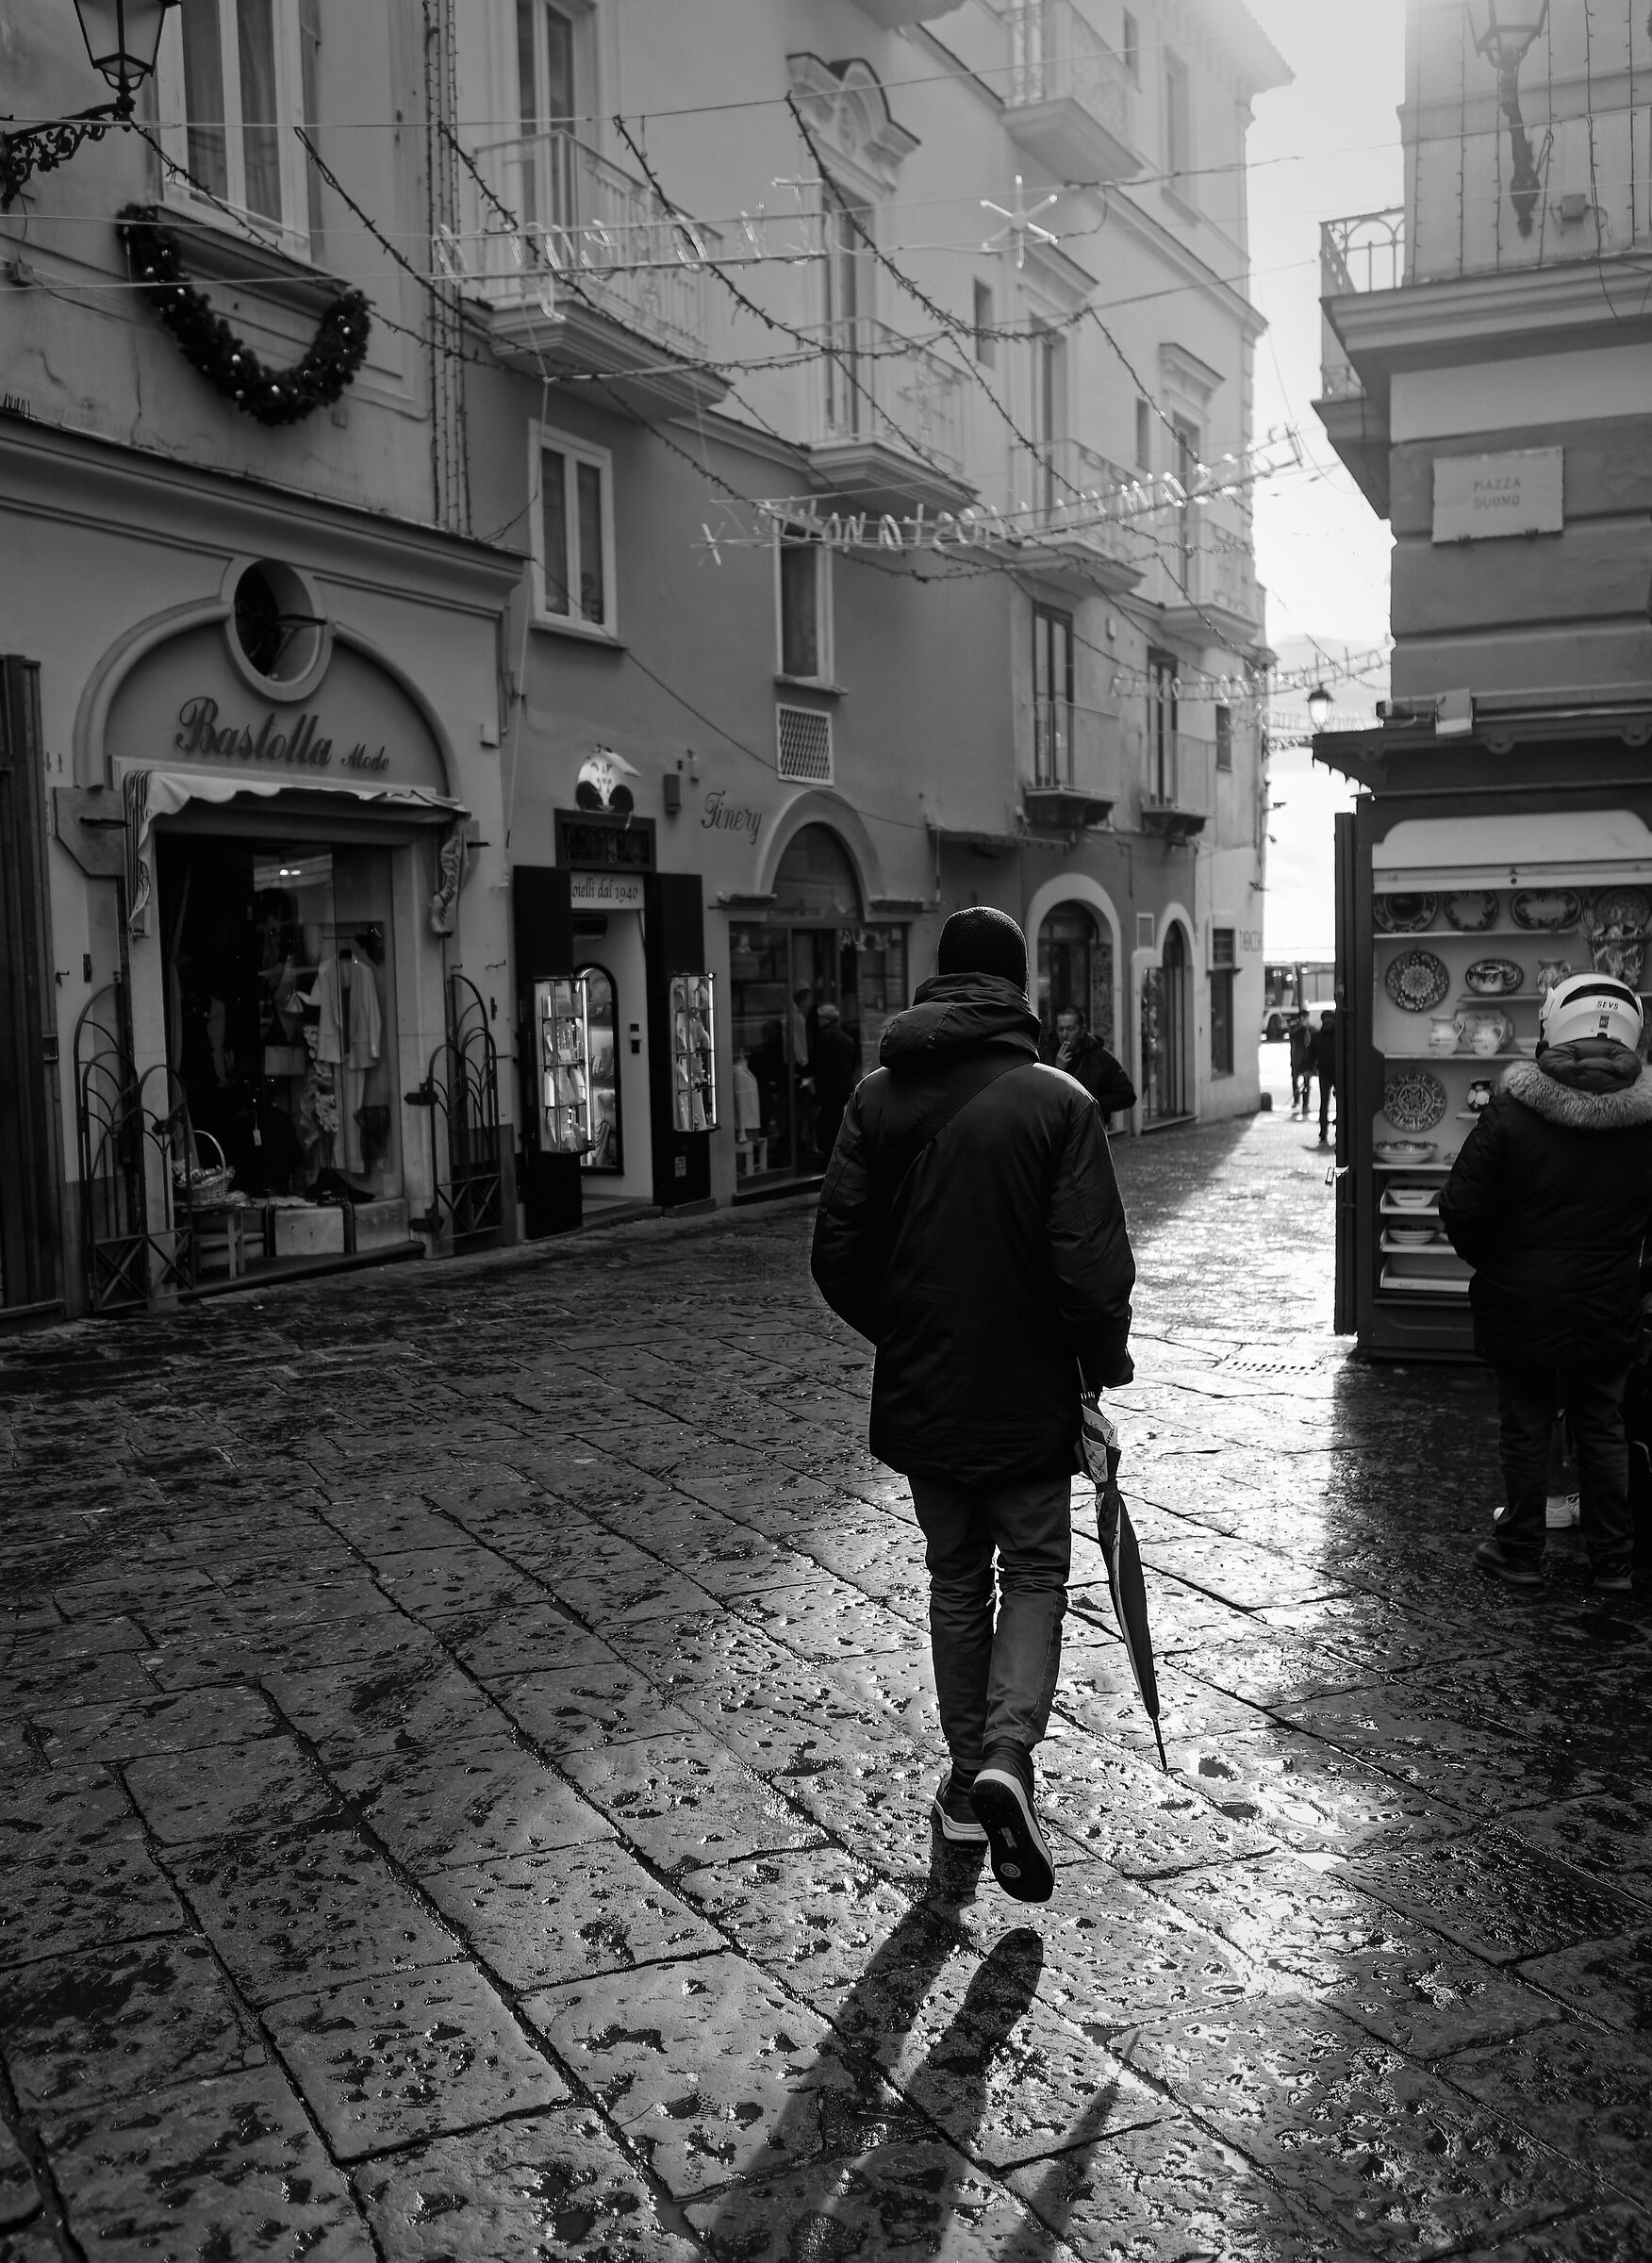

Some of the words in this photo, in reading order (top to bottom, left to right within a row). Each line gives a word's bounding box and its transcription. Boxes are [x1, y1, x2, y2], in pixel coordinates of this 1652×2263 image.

[1473, 478, 1521, 491] PIAZZA
[1474, 494, 1520, 509] DUOMO
[701, 789, 762, 846] Finery
[597, 877, 613, 899] dal
[614, 885, 638, 903] 1940
